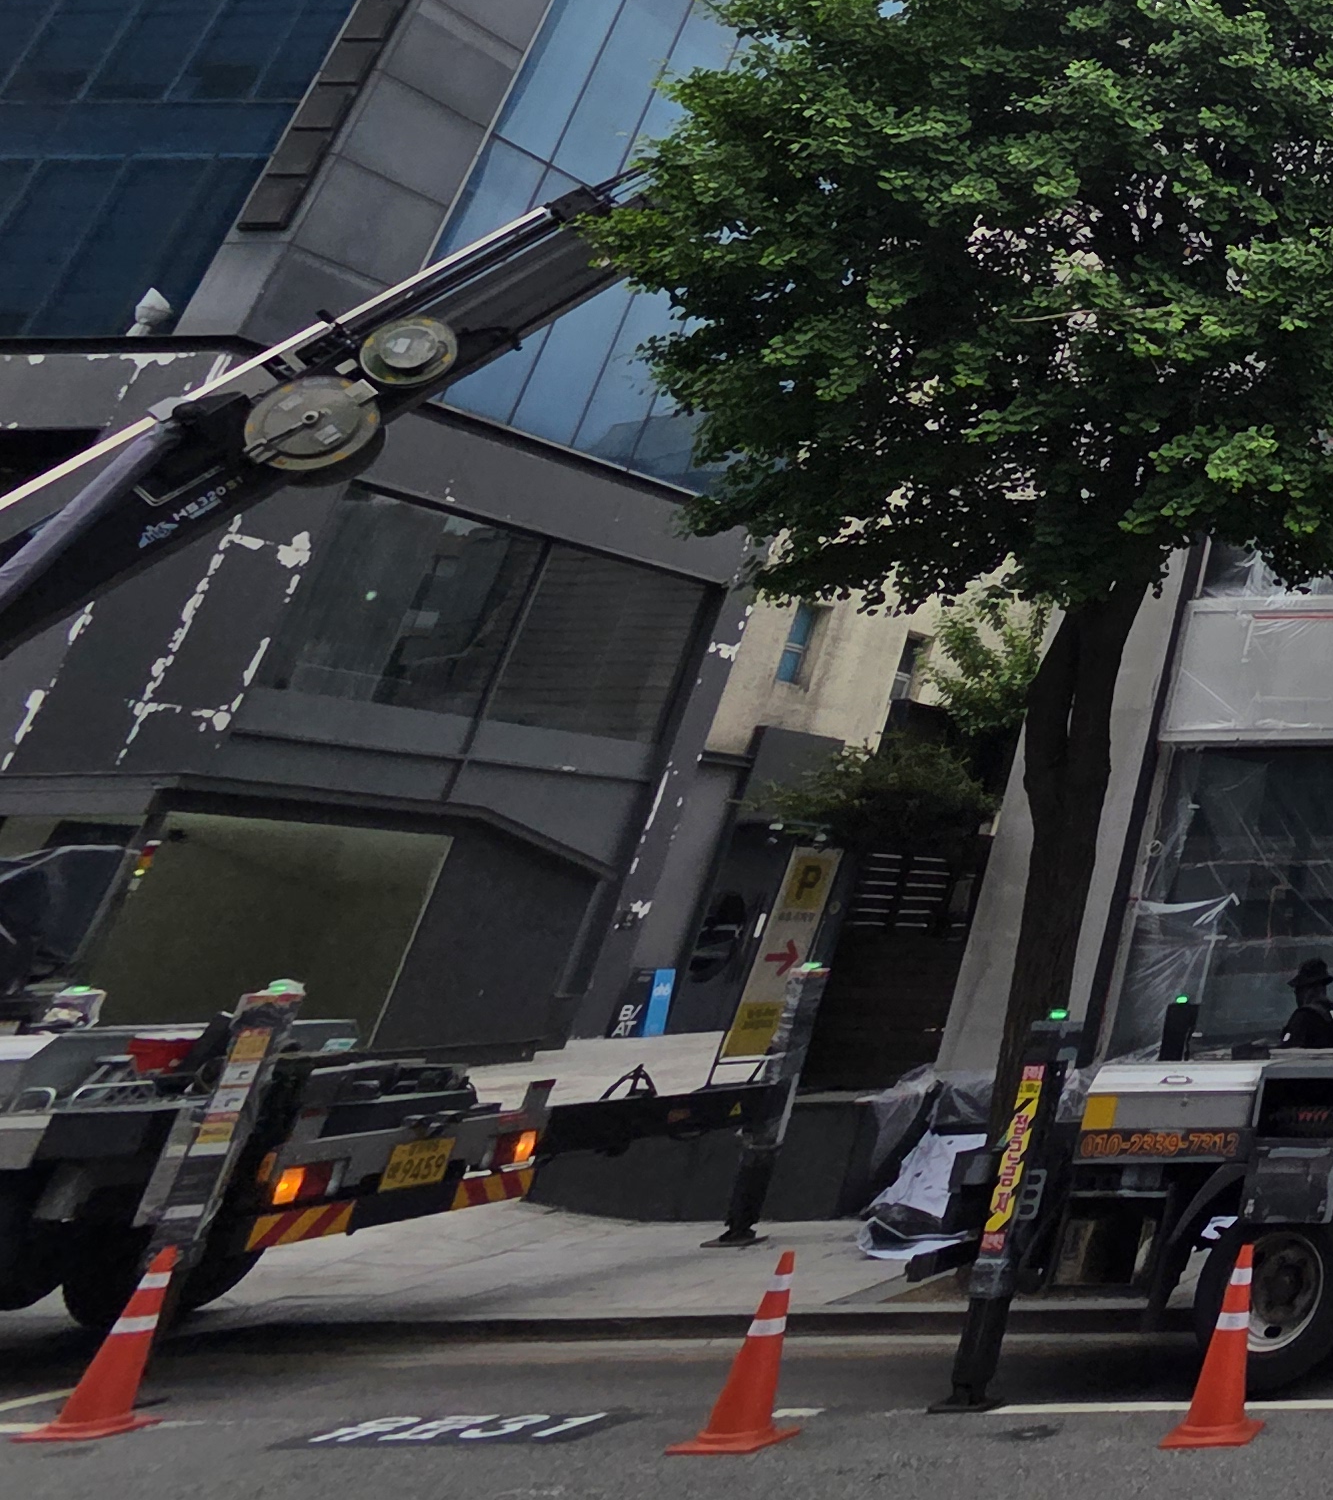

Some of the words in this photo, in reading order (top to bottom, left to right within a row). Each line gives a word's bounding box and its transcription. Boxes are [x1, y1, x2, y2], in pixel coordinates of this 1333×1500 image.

[796, 864, 822, 900] P
[611, 1020, 637, 1038] AT
[1081, 1133, 1240, 1158] 010-2339-7312
[993, 1114, 1030, 1214] 접근금지
